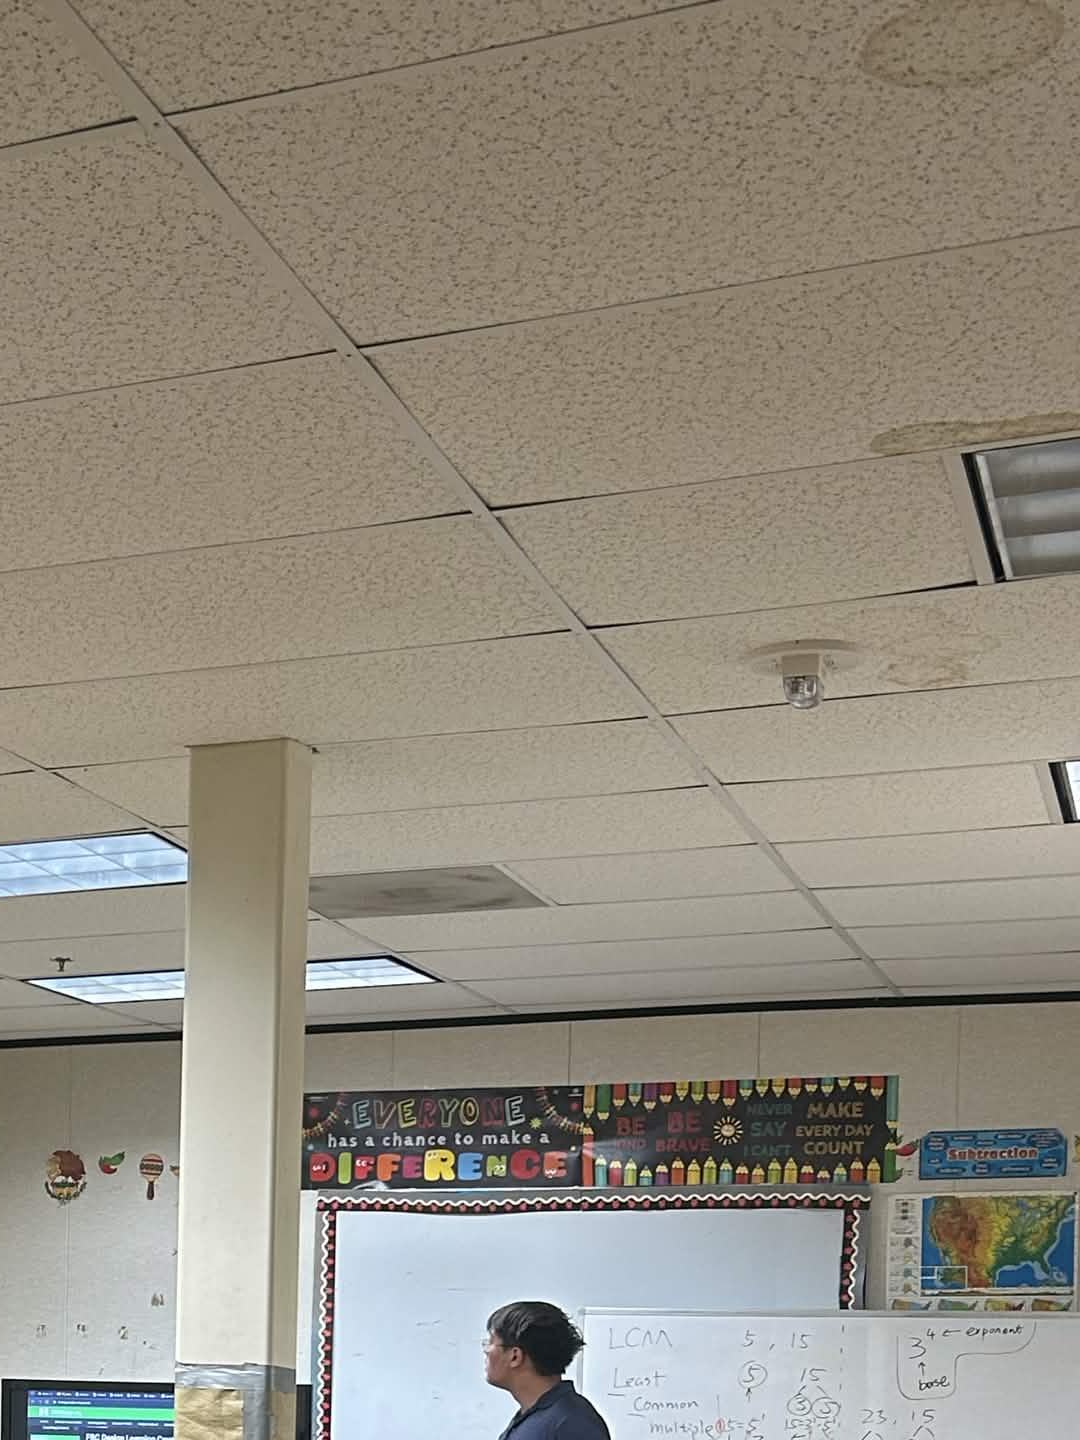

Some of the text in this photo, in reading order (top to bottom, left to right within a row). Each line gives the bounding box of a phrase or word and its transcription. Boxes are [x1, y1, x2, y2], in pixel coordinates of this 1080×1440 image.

[352, 1096, 526, 1129] EVERYONE
[807, 1101, 865, 1119] MAKE
[616, 1116, 647, 1136] BE
[666, 1110, 705, 1134] BE
[751, 1121, 787, 1137] SAY
[795, 1123, 875, 1137] EVERY DAY
[327, 1130, 550, 1148] has a chance to make a
[803, 1141, 865, 1155] COUNT
[947, 1146, 1039, 1161] Subtraction
[309, 1149, 568, 1184] DIFFERENCE
[609, 1327, 673, 1349] LCM
[791, 1332, 815, 1349] 15
[966, 1325, 1023, 1341] exponent
[613, 1367, 668, 1388] Least
[800, 1368, 827, 1382] 15
[918, 1375, 950, 1391] base
[633, 1396, 699, 1412] Common
[911, 1408, 937, 1424] 15
